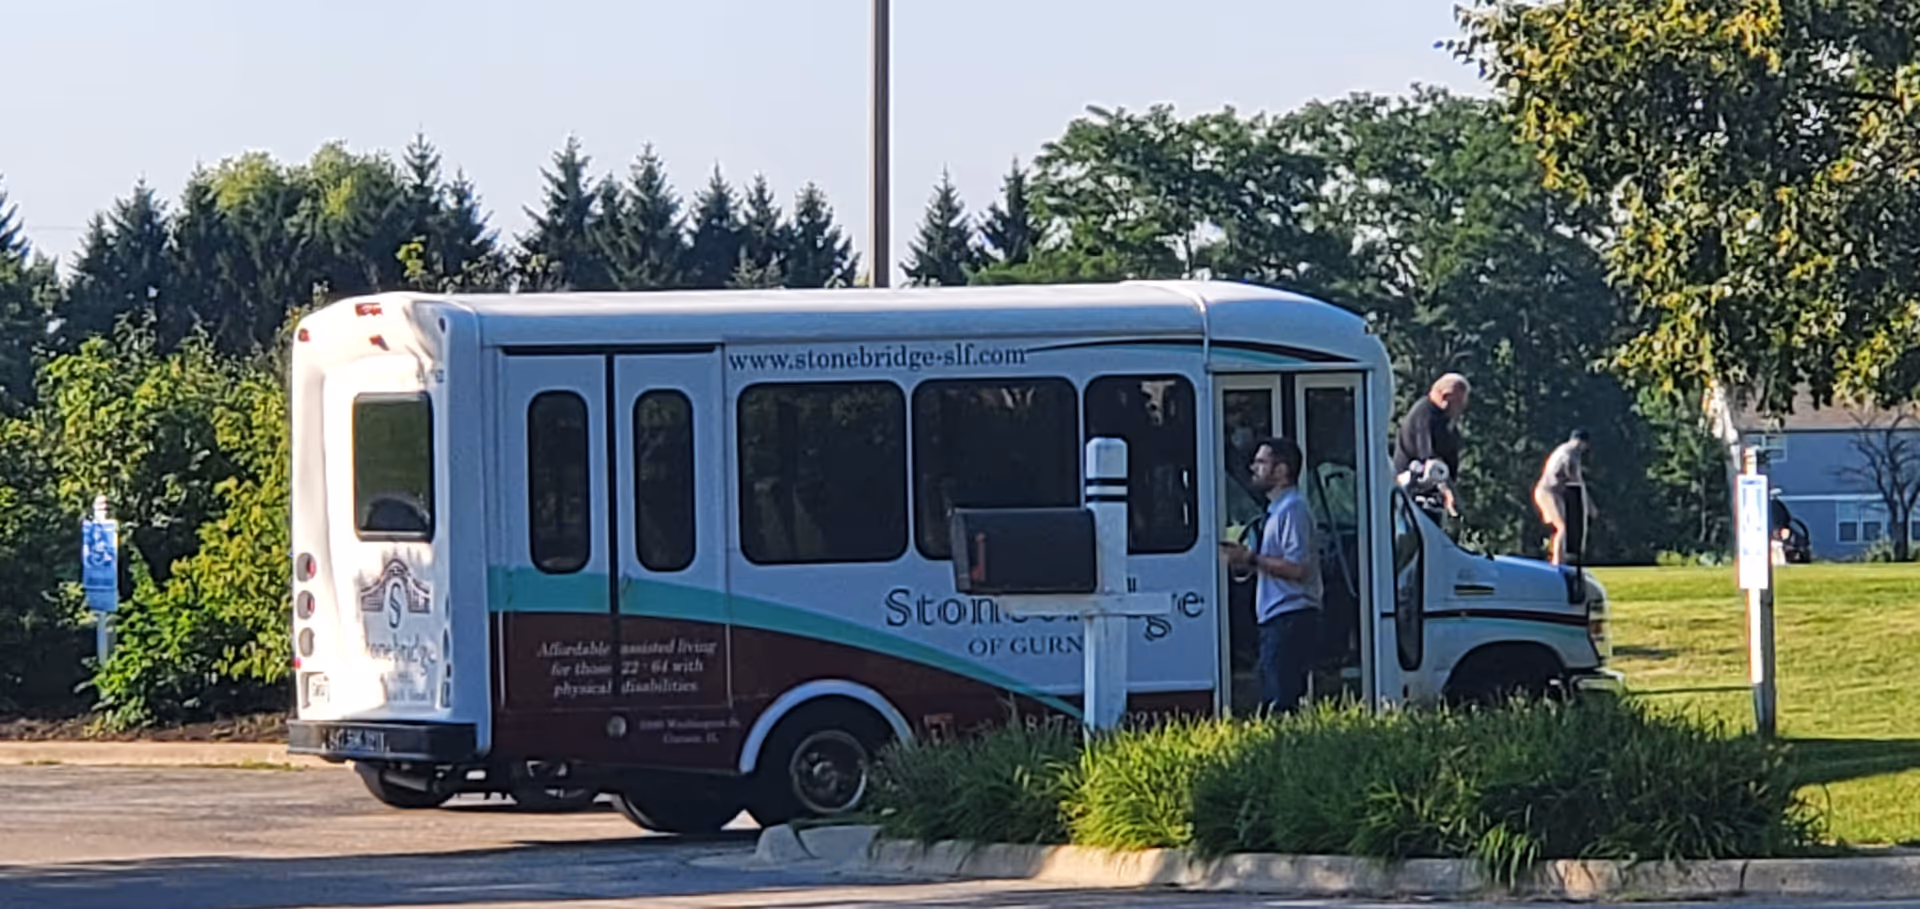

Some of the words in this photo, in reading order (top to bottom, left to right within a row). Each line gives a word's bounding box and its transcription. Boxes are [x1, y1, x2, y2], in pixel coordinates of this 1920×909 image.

[728, 342, 1027, 373] www.stonebridge-slf.com
[537, 640, 612, 658] Affordable
[619, 639, 675, 655] assisted
[677, 637, 718, 656] living
[967, 637, 1002, 658] OF
[1009, 634, 1085, 656] GURN
[551, 662, 571, 677] for
[574, 660, 612, 676] those
[621, 660, 639, 675] 22
[650, 660, 669, 674] 64
[672, 657, 704, 673] with
[553, 680, 613, 699] physical
